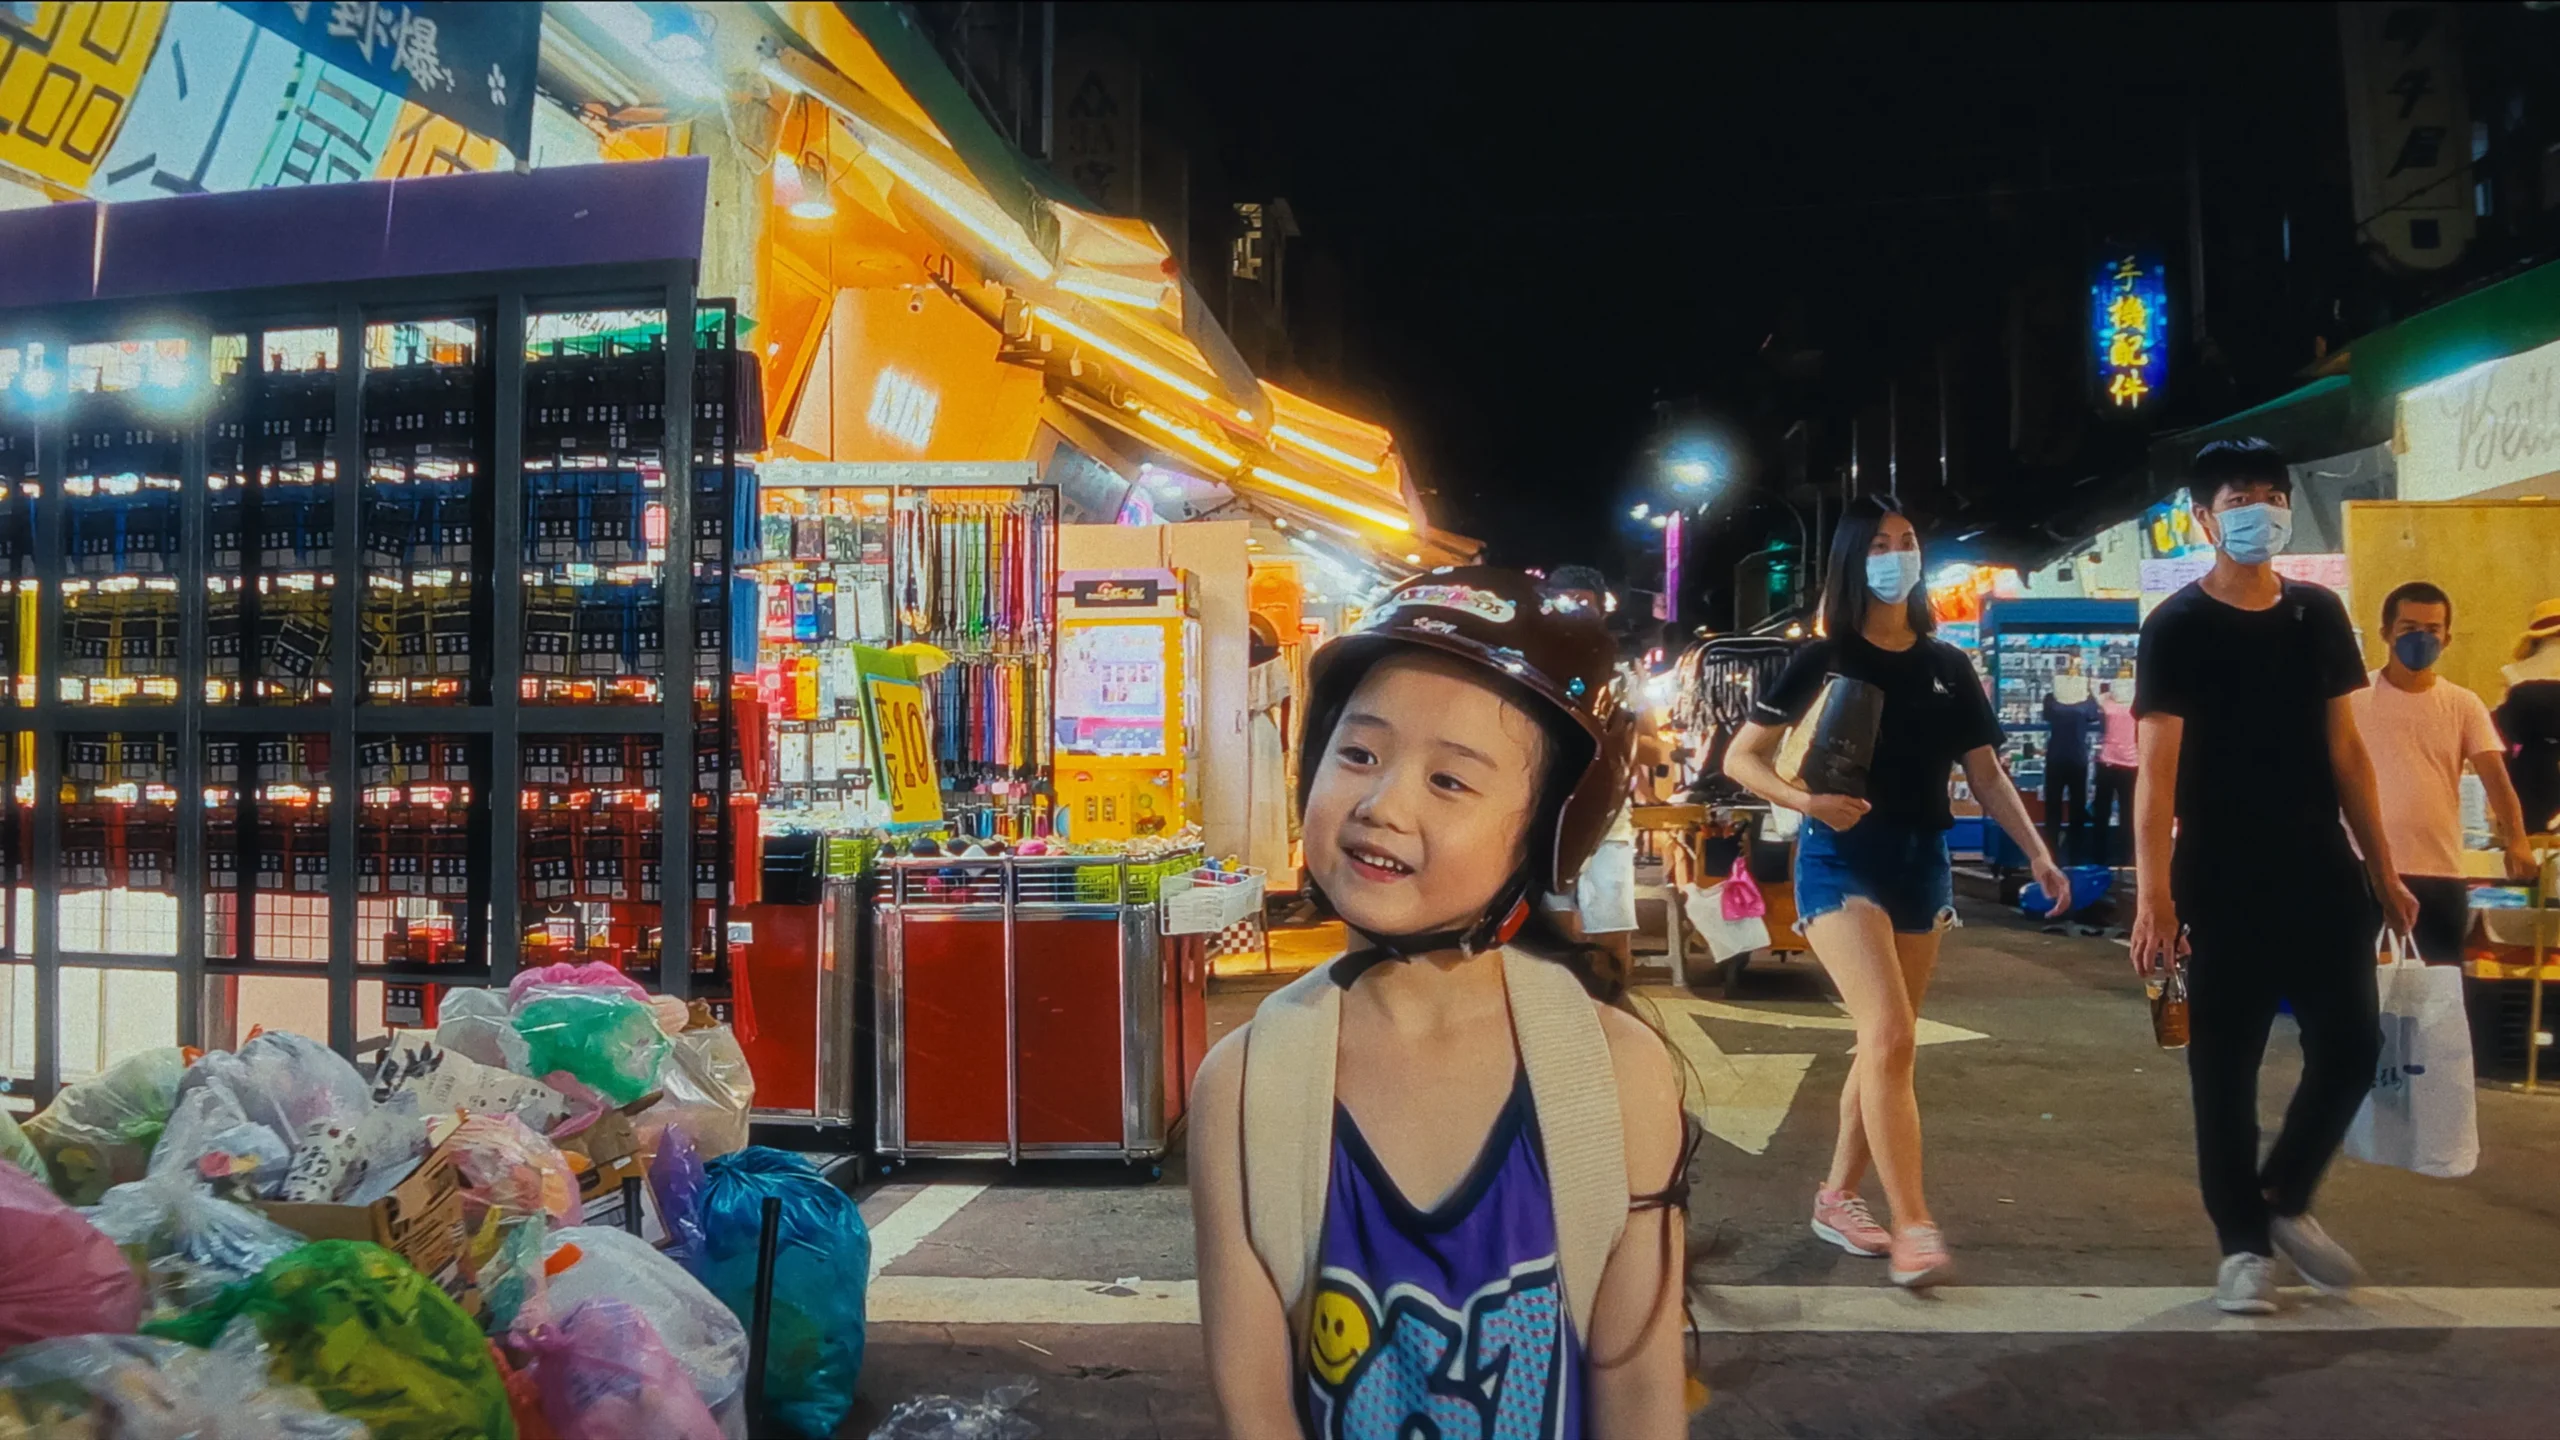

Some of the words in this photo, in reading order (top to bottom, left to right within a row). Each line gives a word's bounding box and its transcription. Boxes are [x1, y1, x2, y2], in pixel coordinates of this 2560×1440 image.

[2109, 255, 2149, 408] 手機配件
[893, 701, 930, 789] 10
